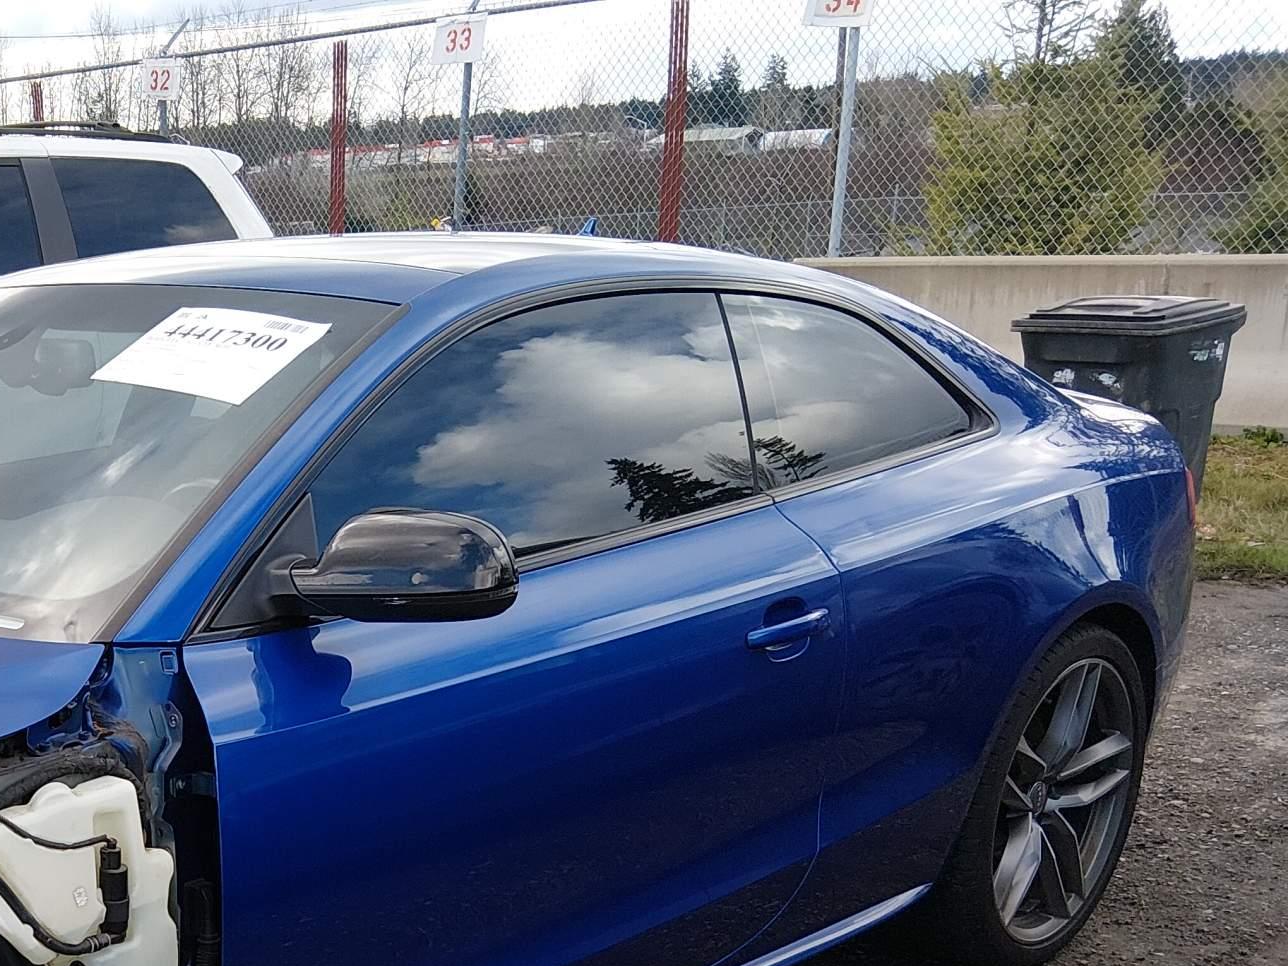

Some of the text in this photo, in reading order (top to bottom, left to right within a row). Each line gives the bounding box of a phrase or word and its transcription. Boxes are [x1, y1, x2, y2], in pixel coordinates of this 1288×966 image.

[445, 27, 472, 53] 33
[150, 69, 170, 91] 32
[164, 324, 288, 352] 44417300
